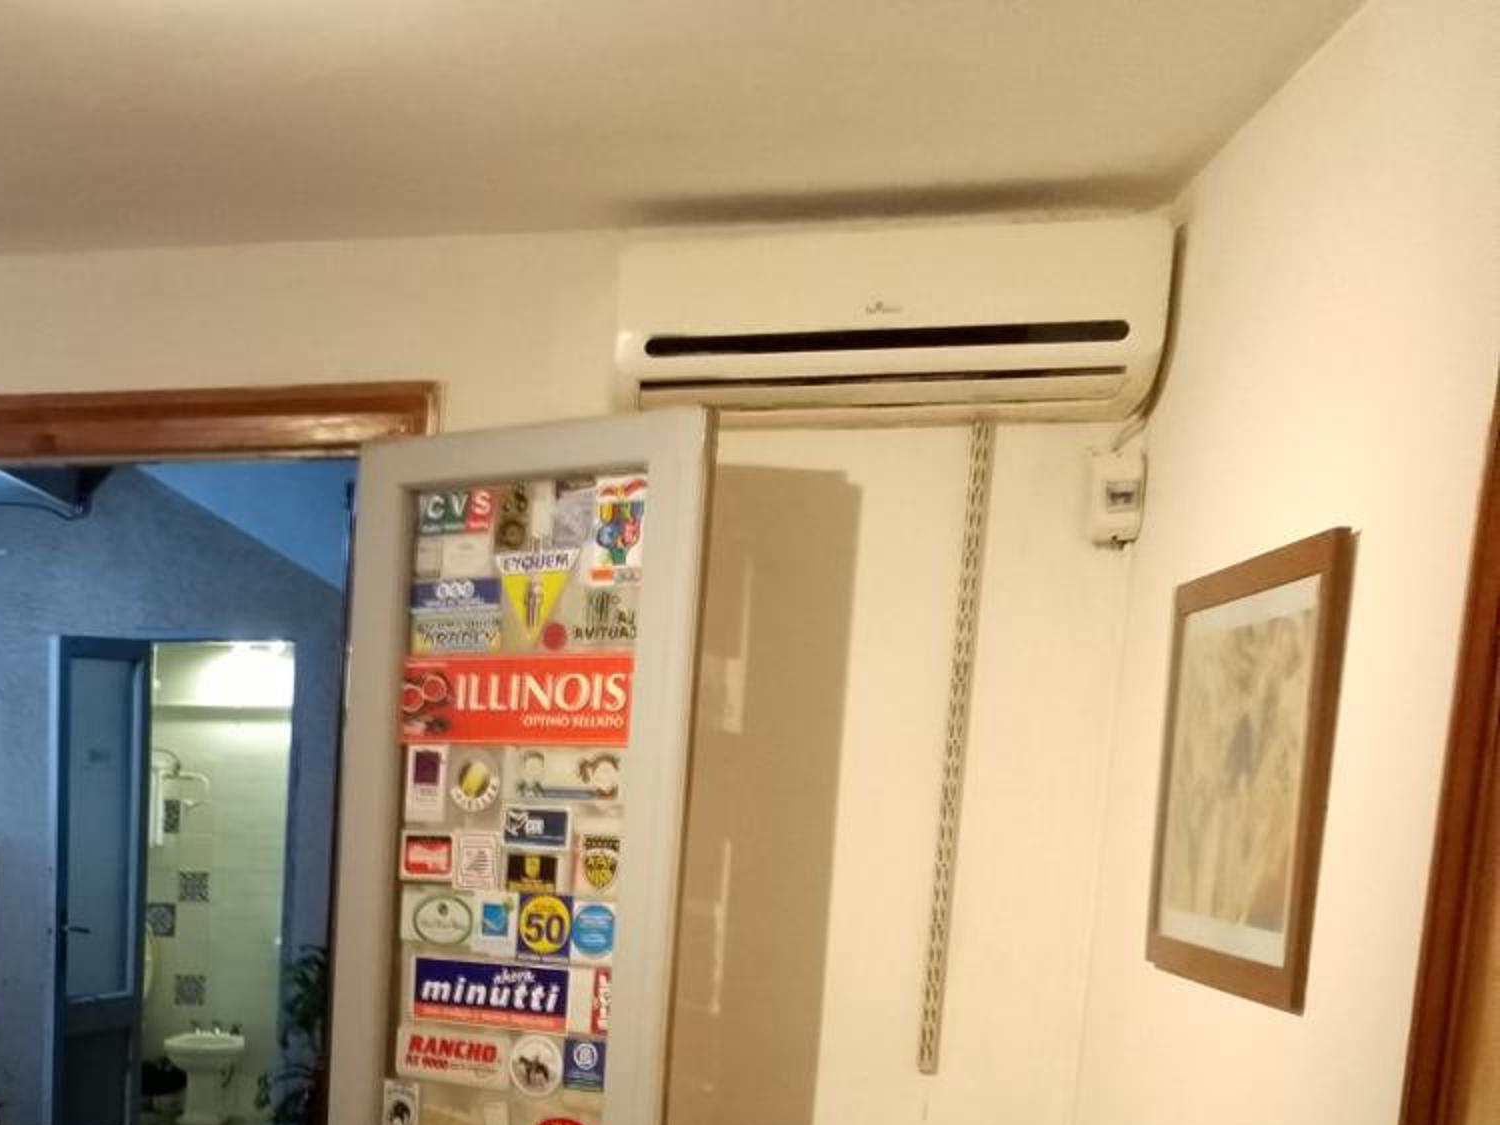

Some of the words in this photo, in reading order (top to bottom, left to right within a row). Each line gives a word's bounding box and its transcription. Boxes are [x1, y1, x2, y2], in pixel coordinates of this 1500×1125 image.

[456, 671, 628, 712] ILLINOIS
[524, 912, 566, 945] 50
[421, 975, 560, 1013] minutti
[408, 1034, 498, 1064] RANCHO
